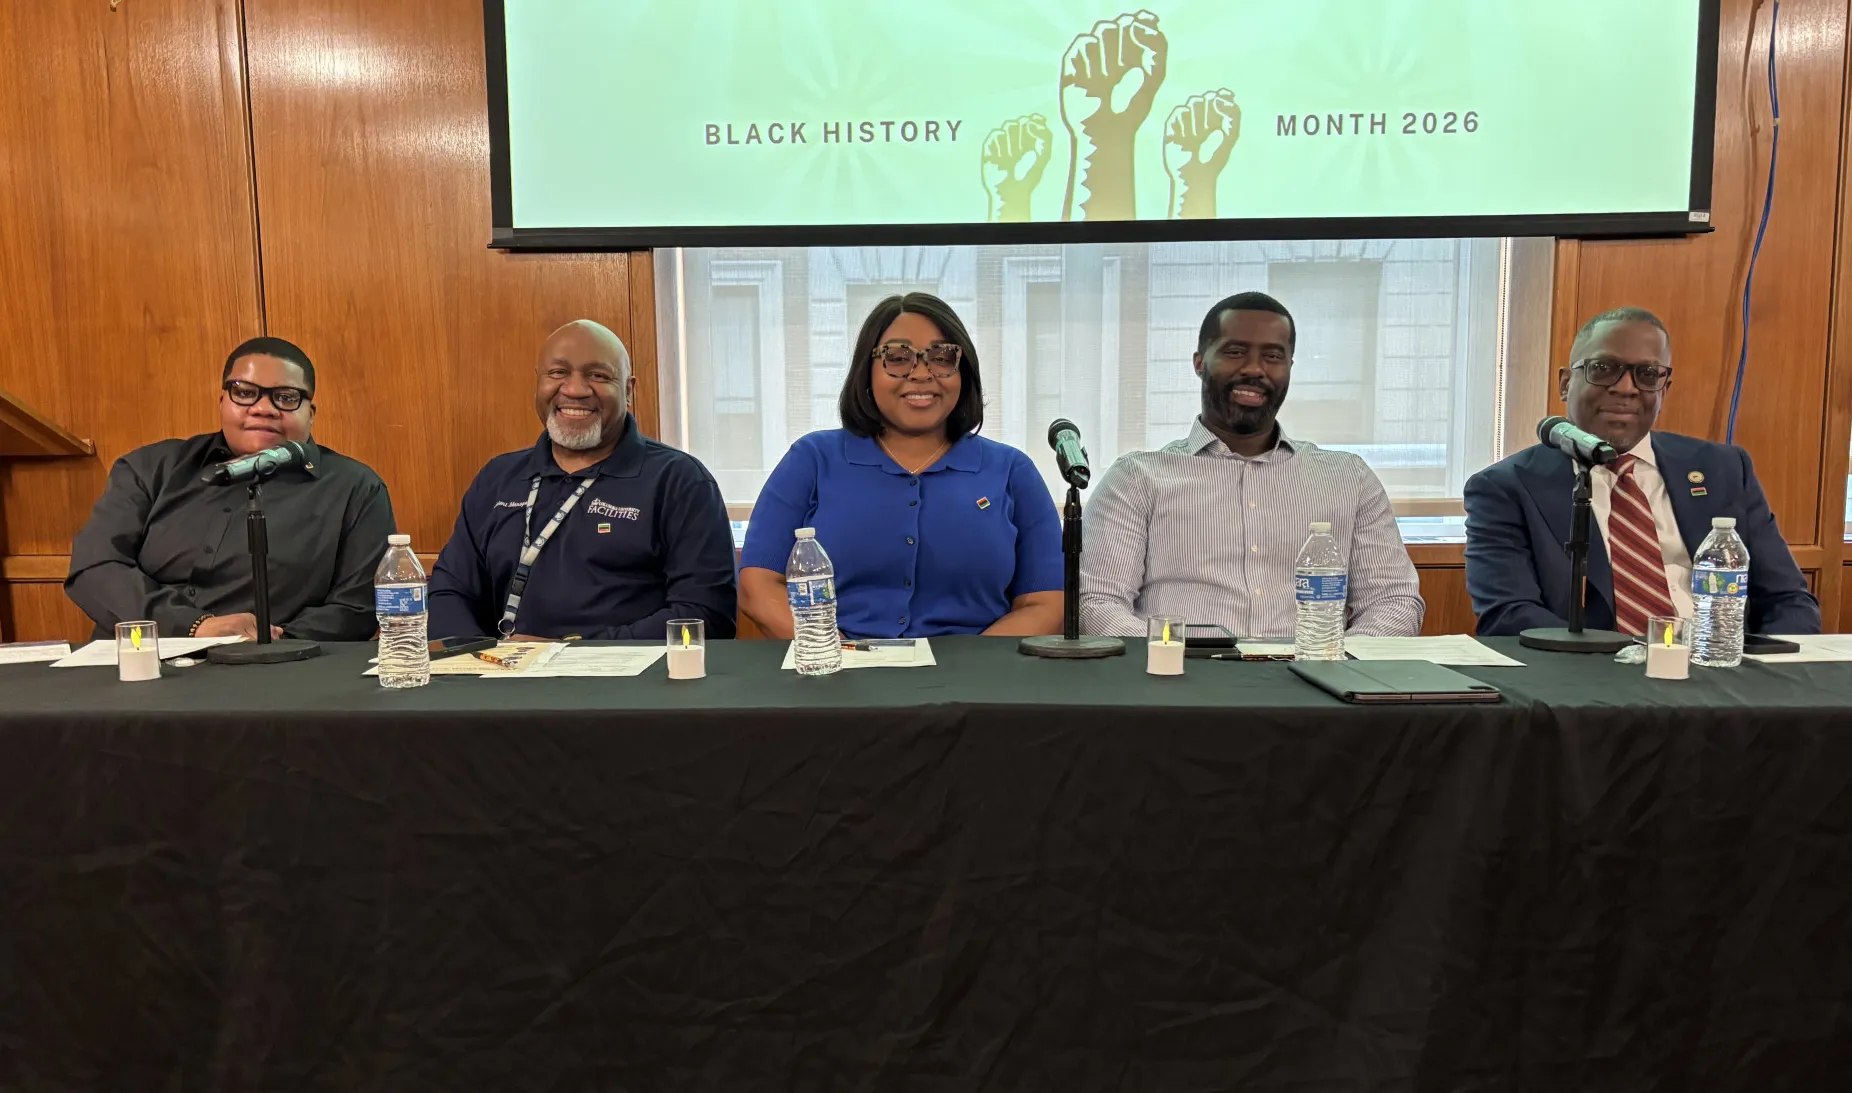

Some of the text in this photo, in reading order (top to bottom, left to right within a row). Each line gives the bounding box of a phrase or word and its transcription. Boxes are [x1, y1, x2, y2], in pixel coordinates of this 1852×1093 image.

[705, 119, 962, 145] BLACK HISTORY
[1276, 110, 1479, 136] MONTH 2026
[587, 504, 640, 521] FACILITIES
